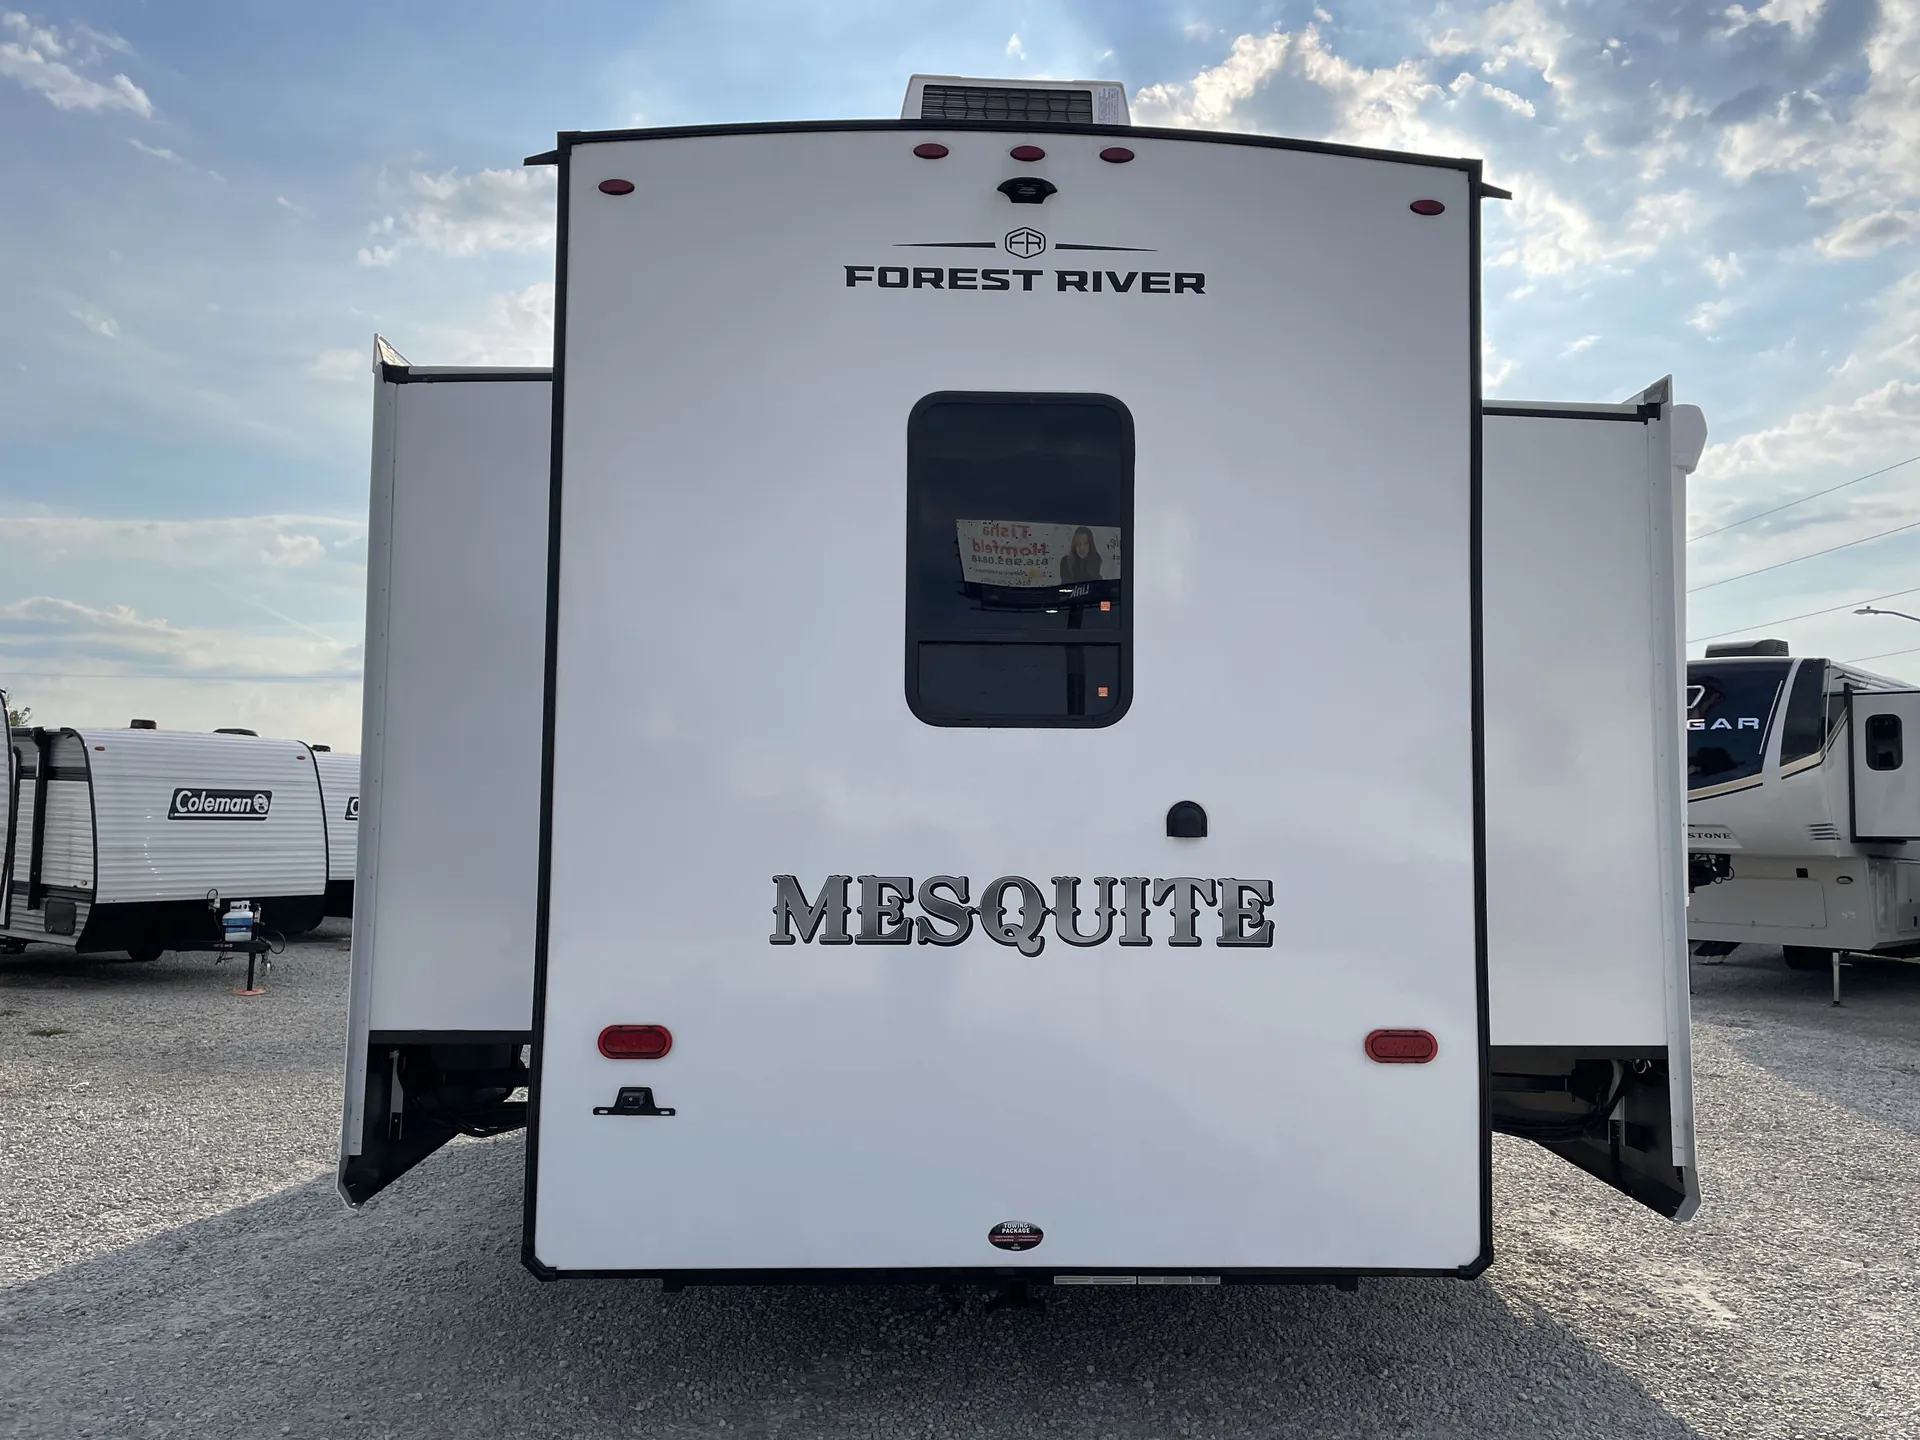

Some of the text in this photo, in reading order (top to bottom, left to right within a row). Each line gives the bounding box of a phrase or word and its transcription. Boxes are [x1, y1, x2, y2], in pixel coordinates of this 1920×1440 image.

[844, 265, 1206, 294] FOREST RIVER
[1686, 717, 1760, 730] GAR
[175, 790, 252, 813] Coleman
[1688, 831, 1732, 840] STONE
[769, 874, 1275, 957] MESQUITE
